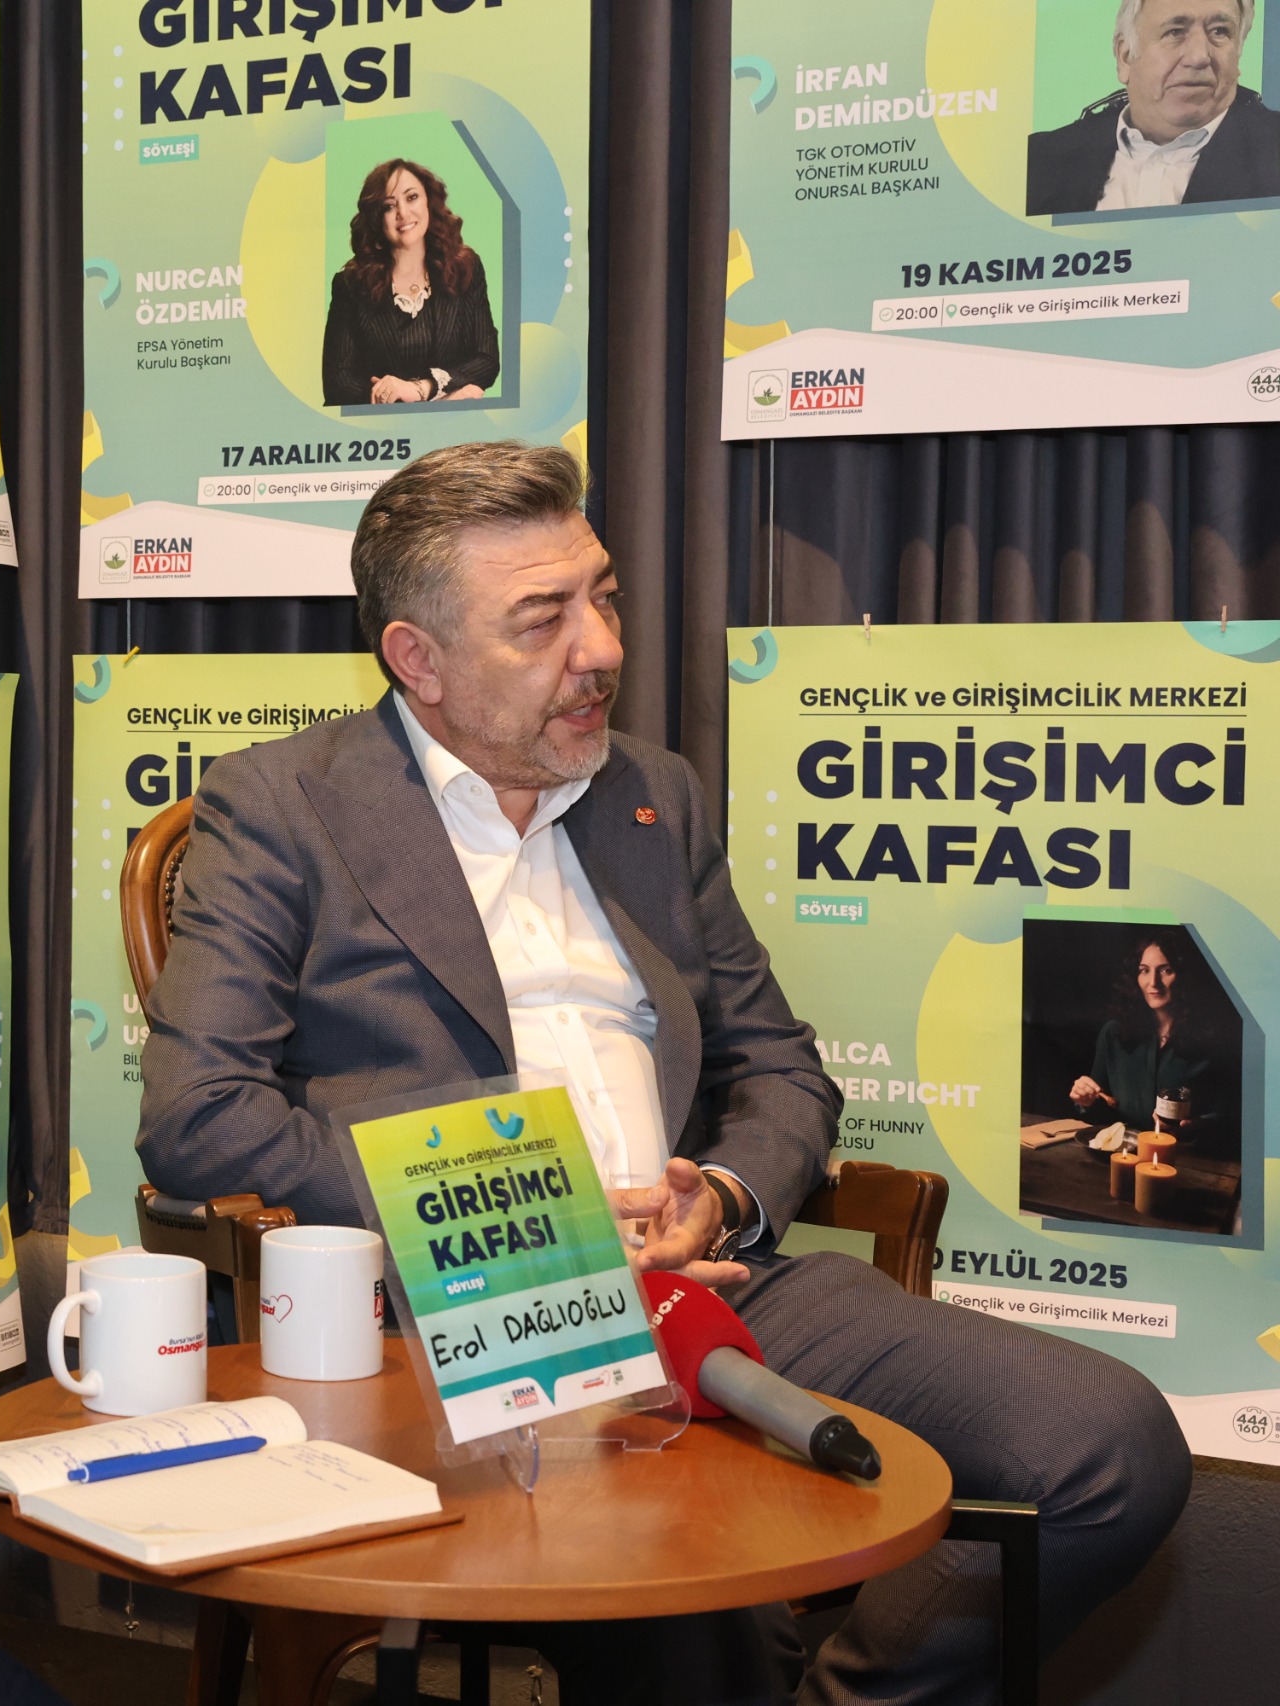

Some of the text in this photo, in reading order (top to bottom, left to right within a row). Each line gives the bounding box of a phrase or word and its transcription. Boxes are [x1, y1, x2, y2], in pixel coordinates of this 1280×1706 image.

[139, 42, 412, 125] KAFASI
[795, 62, 888, 94] İRFAN
[795, 88, 997, 131] DEMİRDÜZEN
[142, 140, 195, 159] SÖYLEŞİ
[796, 137, 916, 162] TGK OTOMOTİV
[796, 158, 929, 182] YÖNETİM KURULU
[795, 176, 940, 201] ONURSAL BAŞKANI
[136, 264, 243, 293] NURCAN
[901, 249, 1132, 288] 19 KASIM 2025
[136, 293, 247, 325] ÖZDEMİR
[895, 291, 1181, 320] 20:00 Gençlik ve Girişimcilik Merkezi
[137, 336, 224, 353] EPSA Yönetim
[137, 354, 231, 370] Kurulu Başkanı
[791, 368, 864, 388] ERKAN
[1251, 375, 1280, 385] 444
[1252, 385, 1280, 394] 1601
[792, 388, 860, 409] AYDIN
[222, 438, 411, 467] 17 ARALIK 2025
[217, 484, 251, 496] 20:00
[268, 482, 310, 498] Gençlik
[314, 484, 327, 493] ve
[133, 537, 192, 554] ERKAN
[135, 555, 189, 572] AYDIN
[800, 682, 1247, 713] GENÇLİK ve GİRİŞİMCİLİK MERKEZİ
[127, 704, 212, 730] GENÇLİK
[217, 711, 242, 725] ve
[797, 726, 1246, 815] GİRİŞİMCİ
[797, 823, 1131, 890] KAFASI
[799, 901, 864, 920] SÖYLEŞİ
[888, 1080, 982, 1108] PICHT
[845, 1117, 925, 1135] OF HUNNY
[404, 1135, 557, 1178] GENÇLİK ve GİRİŞİMCİLİK MERKEZİ
[416, 1157, 573, 1226] GİRİŞİMCİ
[428, 1214, 557, 1272] KAFASI
[951, 1248, 1128, 1289] EYLÜL 2025
[446, 1274, 485, 1295] SÖYLEŞİ
[952, 1294, 1168, 1328] Gençlik ve Girişimcilik Merkezi
[430, 1289, 626, 1368] Erol DAĞLIOĞLU
[1237, 1414, 1267, 1426] 444
[1238, 1424, 1266, 1435] 1601
